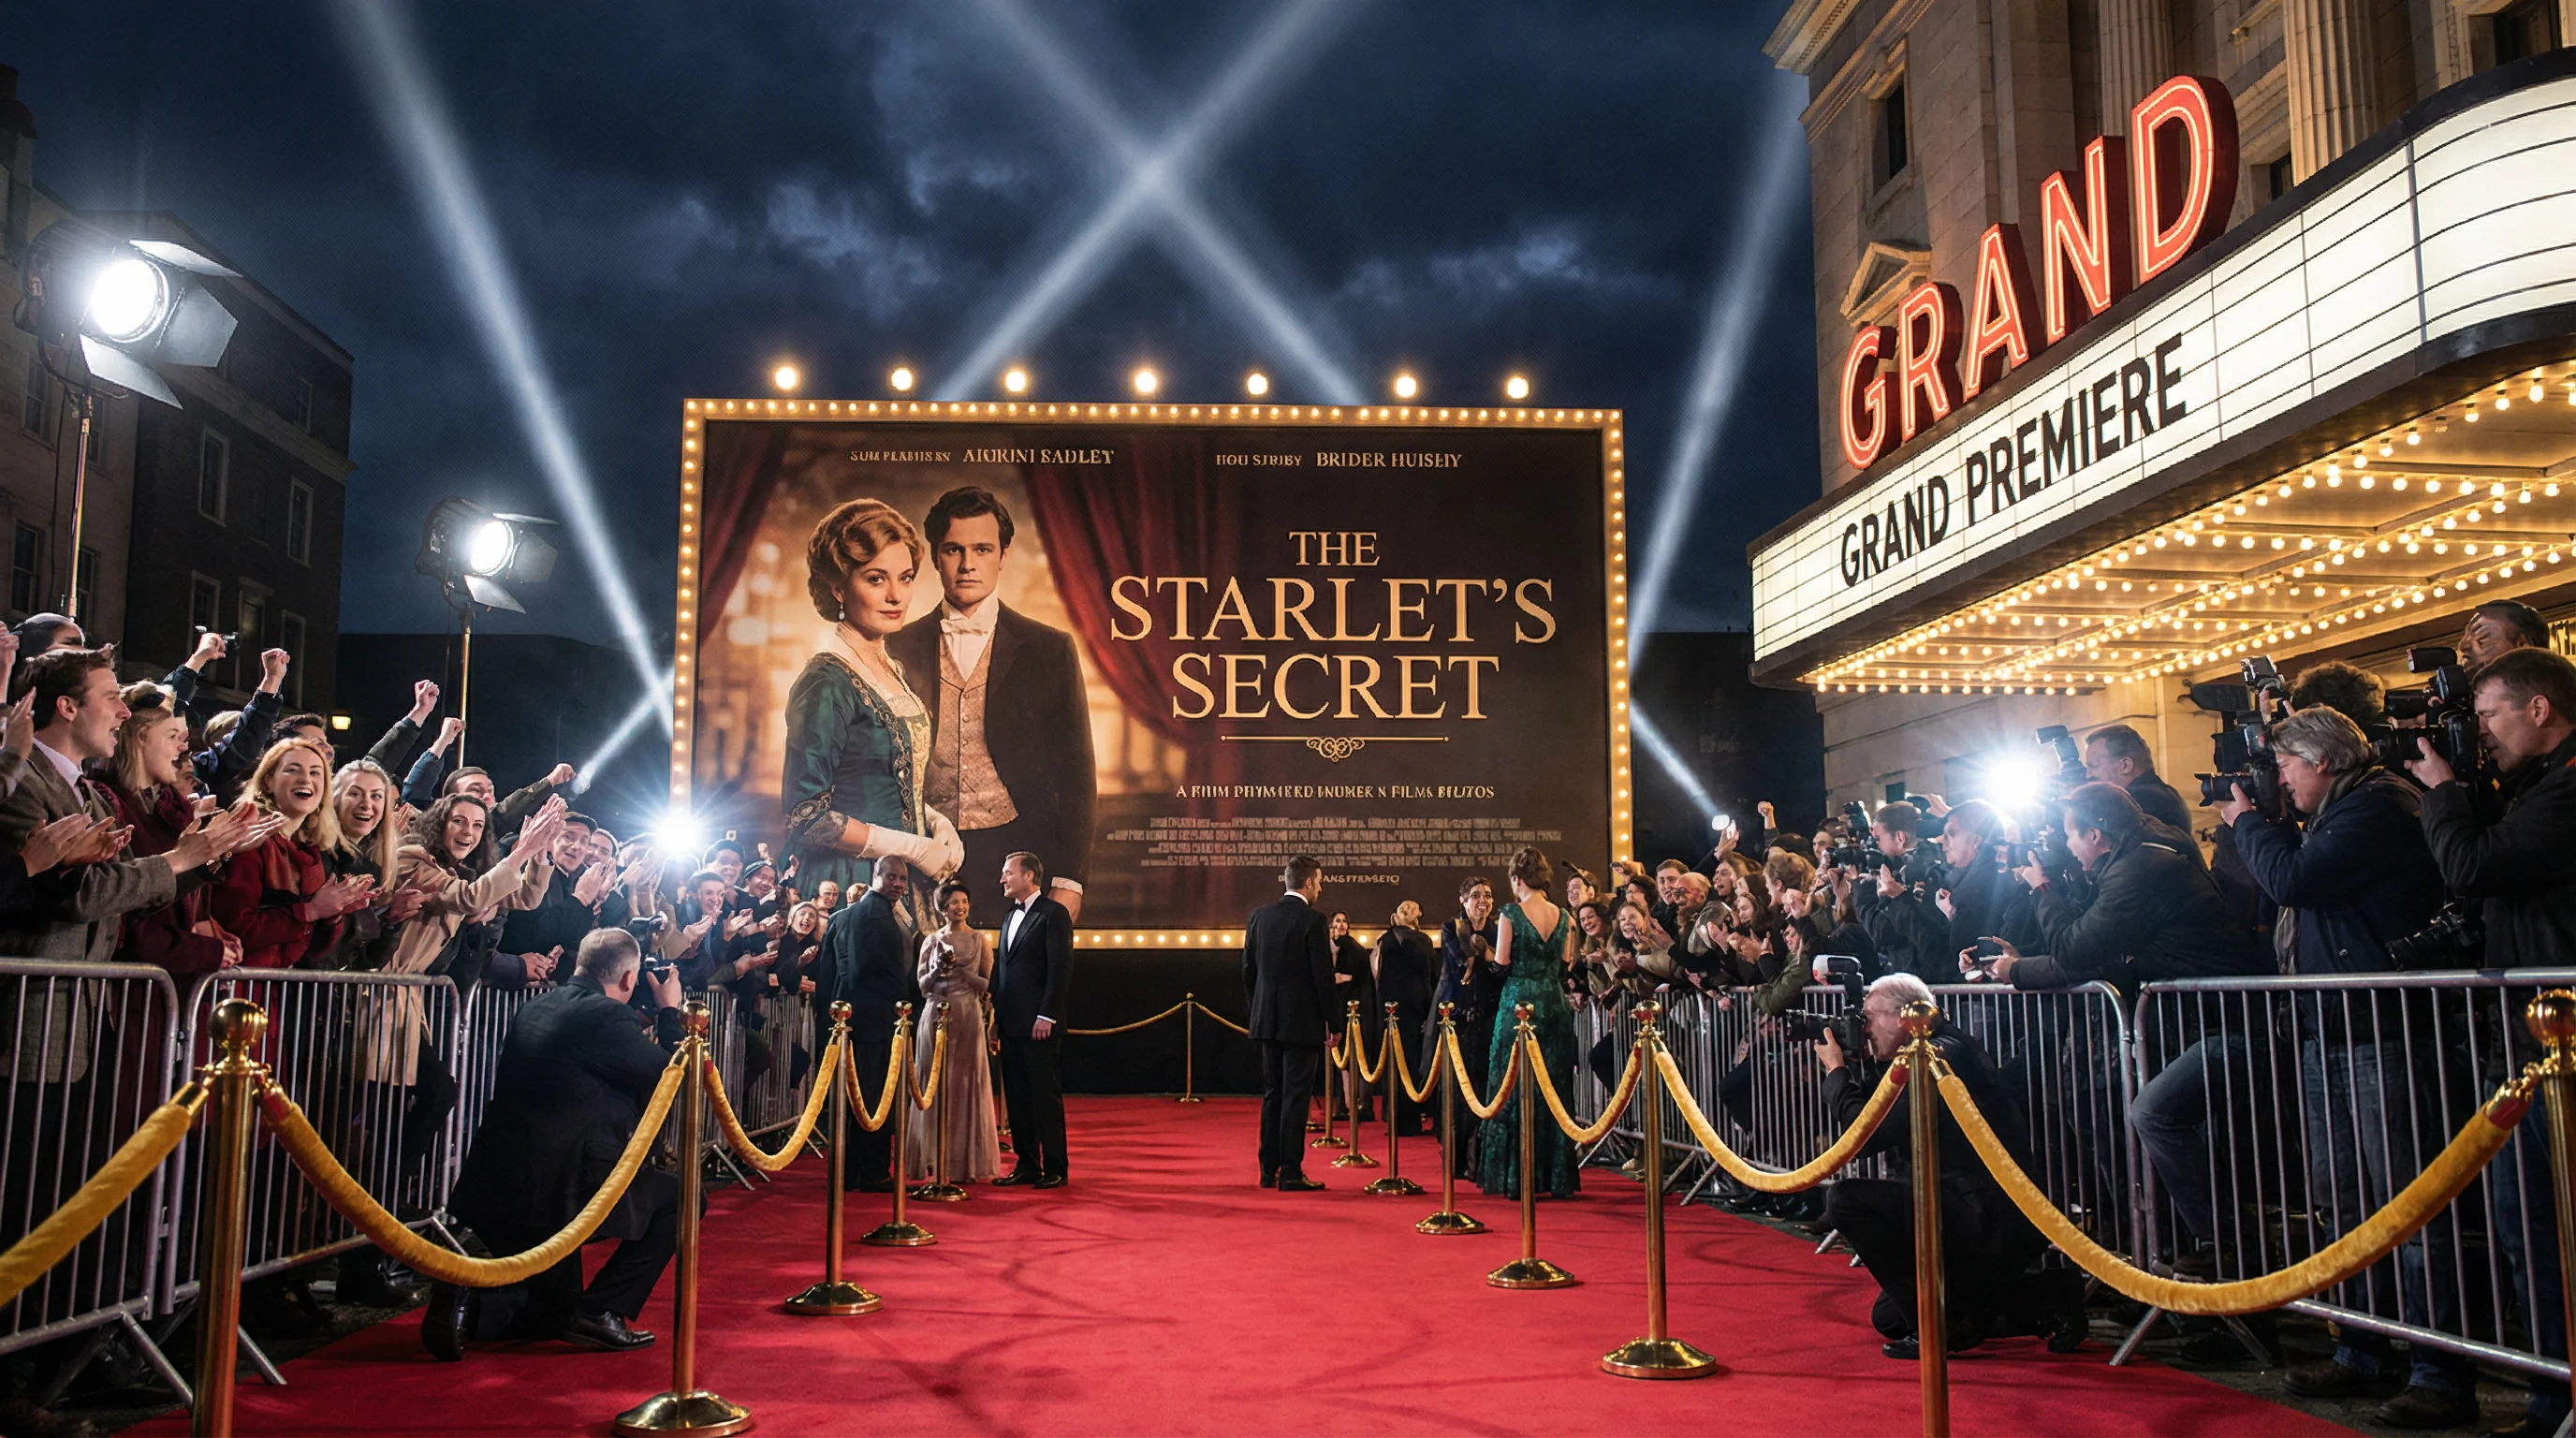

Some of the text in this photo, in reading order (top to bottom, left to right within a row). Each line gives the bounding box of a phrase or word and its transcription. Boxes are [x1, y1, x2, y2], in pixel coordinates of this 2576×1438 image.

[1840, 74, 2217, 469] GRAND
[1316, 451, 1386, 467] BRIDER
[1840, 332, 2188, 588] GRAND PREMIERE
[1288, 531, 1381, 566] THE
[1110, 575, 1557, 644] STARLET’S
[1171, 653, 1500, 720] SECRET
[1176, 785, 1188, 798] A
